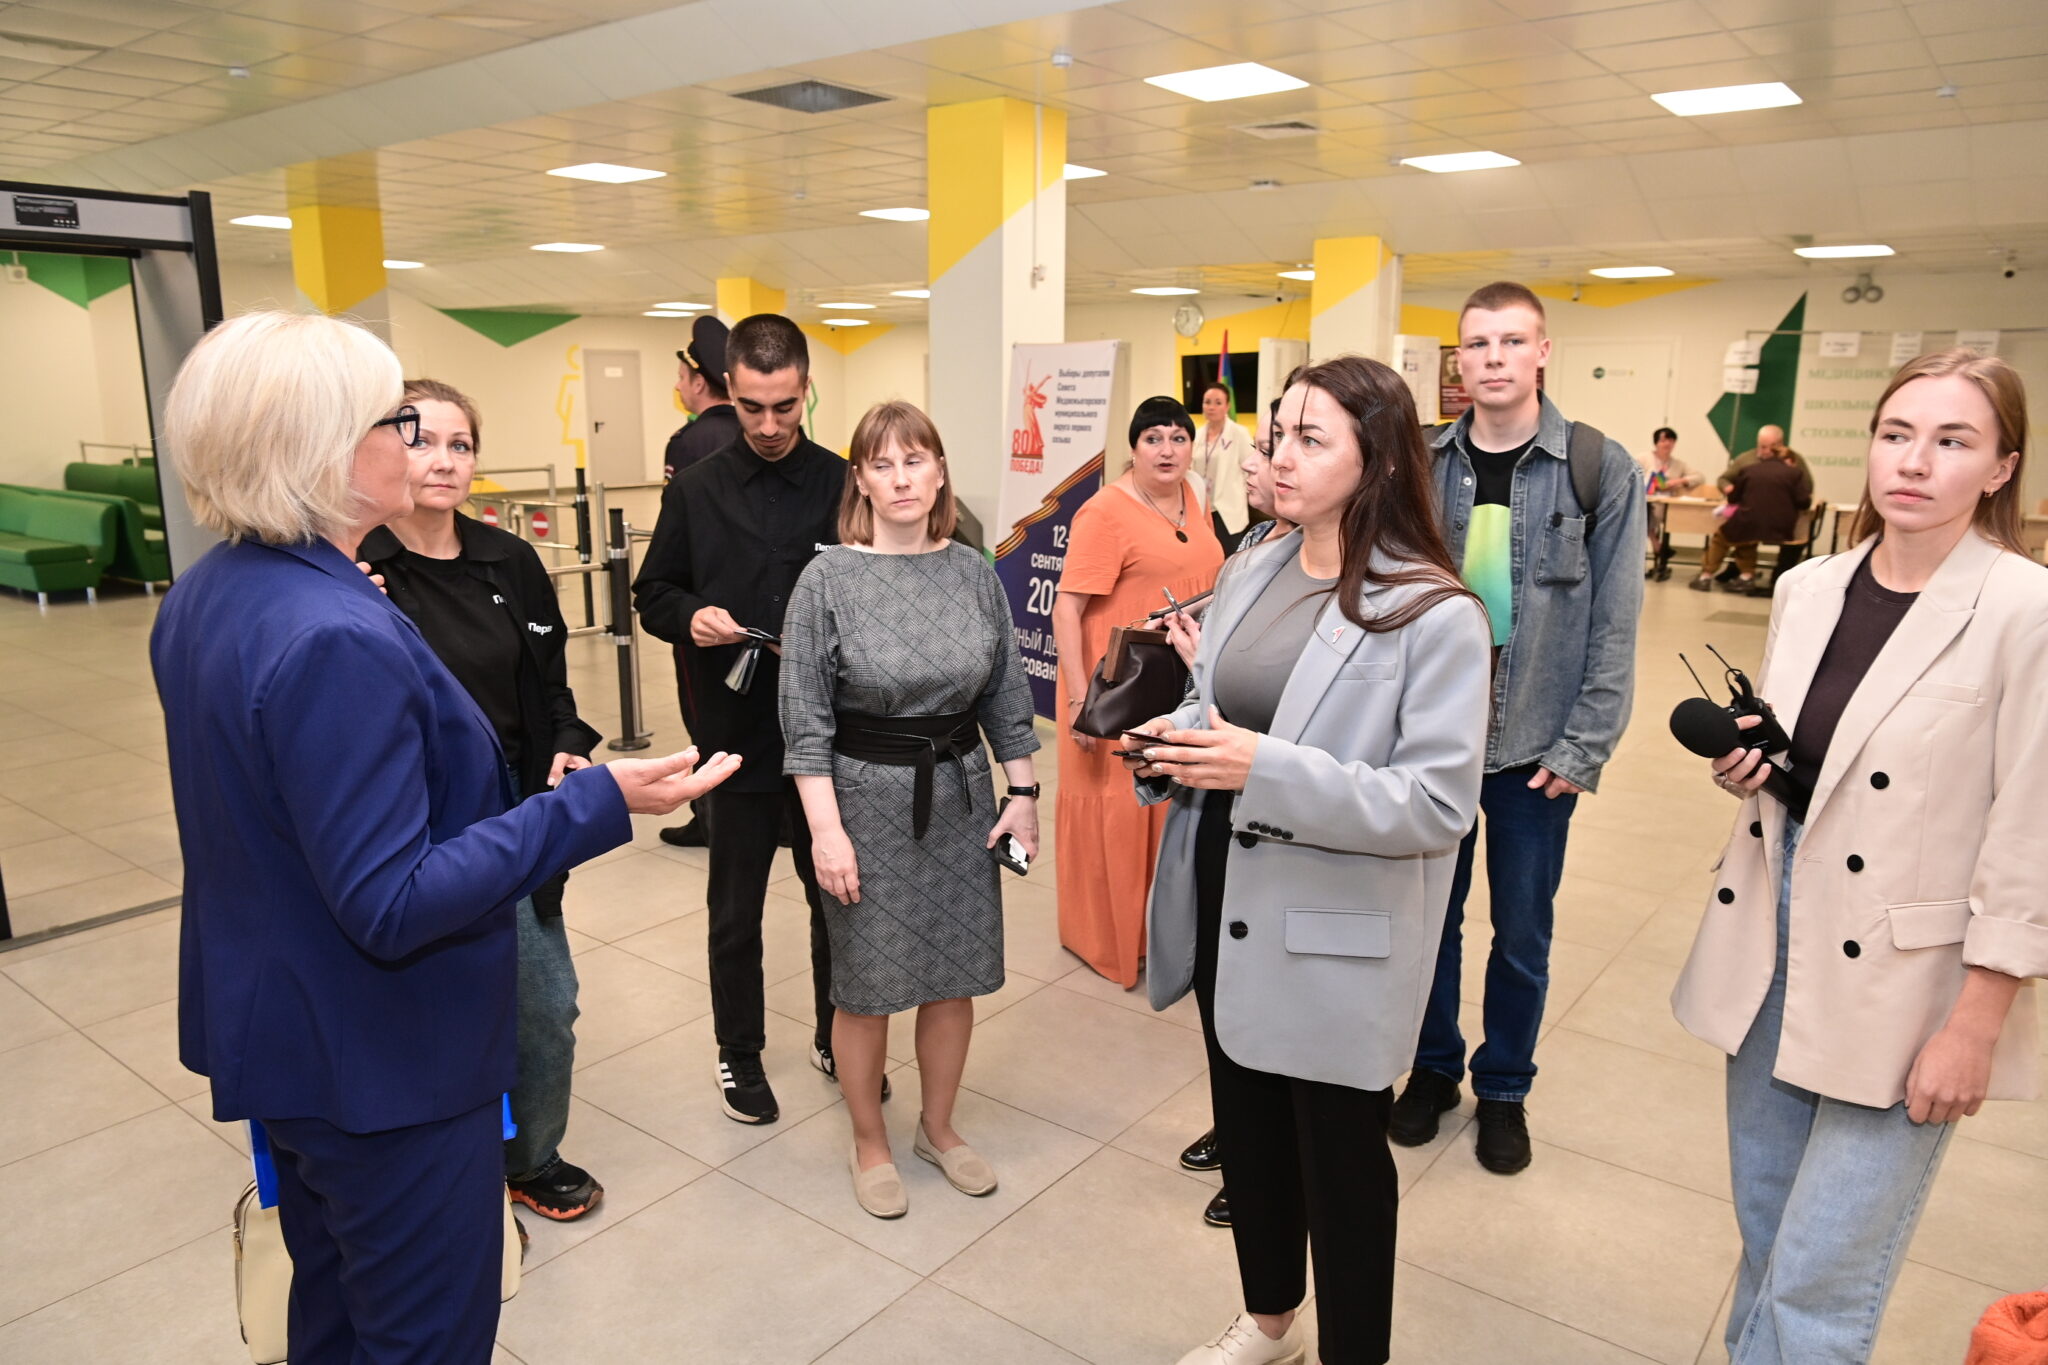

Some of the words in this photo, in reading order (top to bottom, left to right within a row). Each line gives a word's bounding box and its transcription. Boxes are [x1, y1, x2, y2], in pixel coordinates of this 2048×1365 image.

[1057, 382, 1076, 391] Совета
[1012, 429, 1030, 454] 80
[1027, 577, 1060, 616] 20
